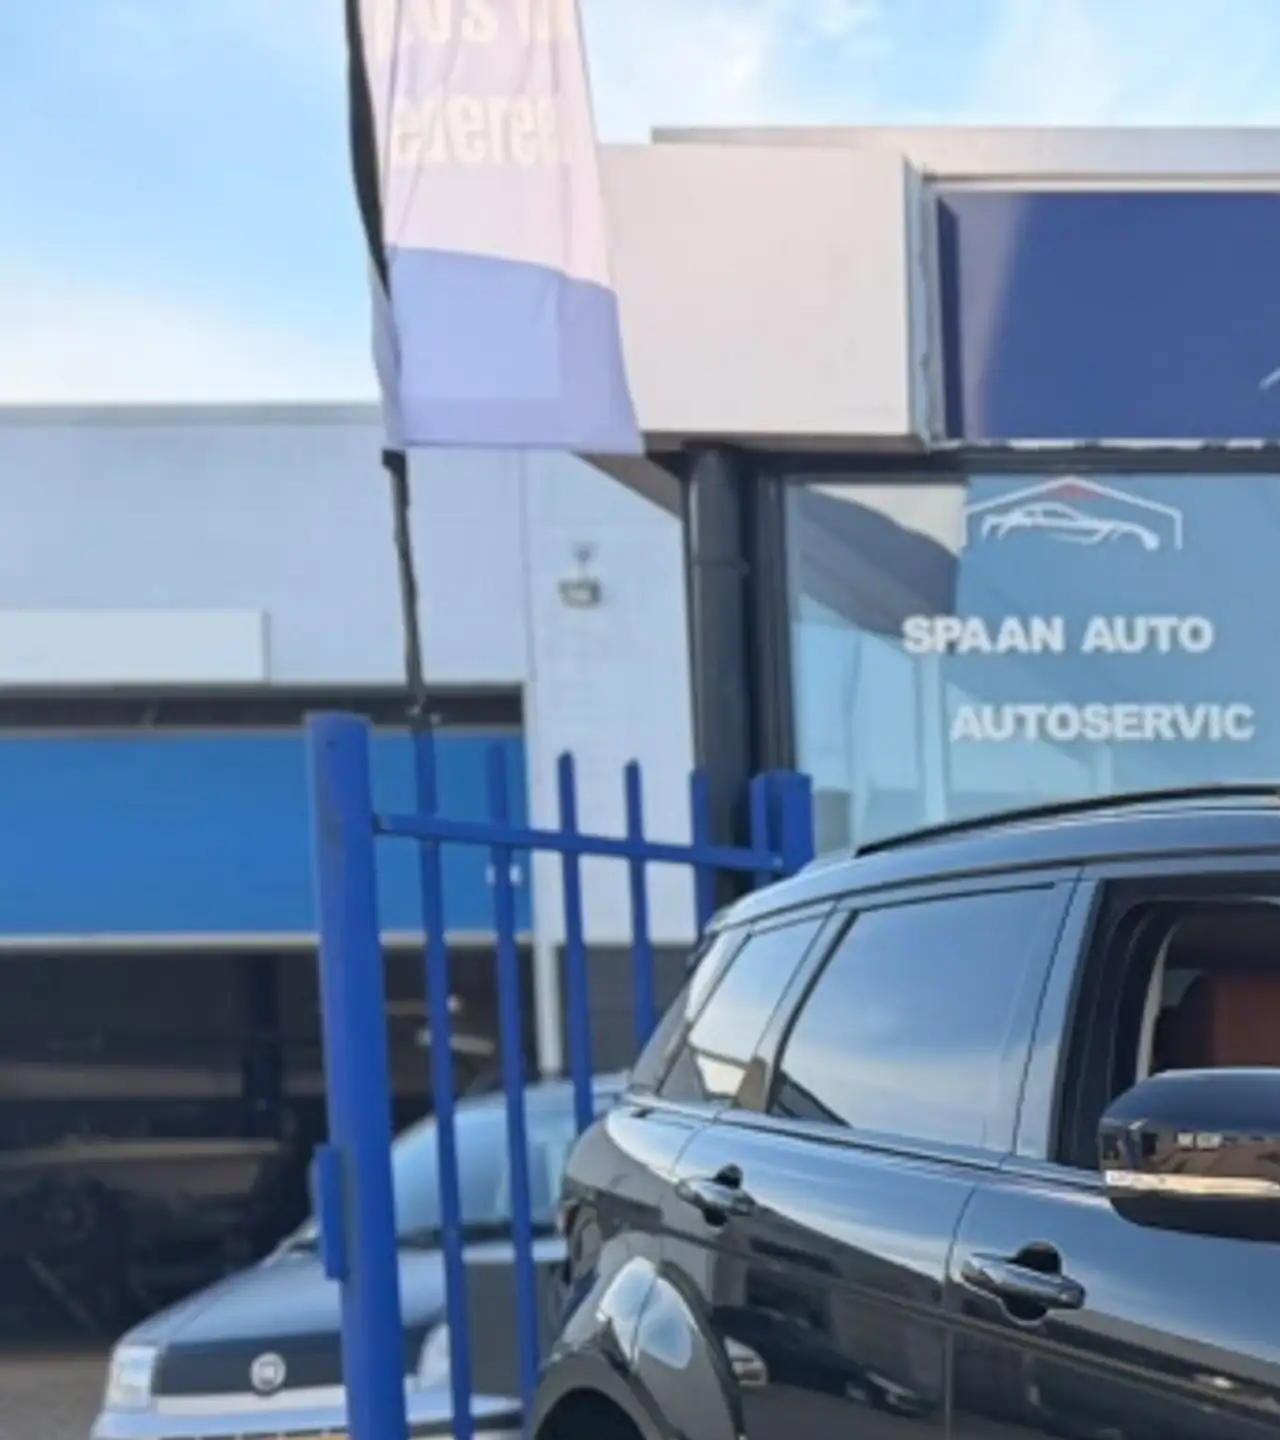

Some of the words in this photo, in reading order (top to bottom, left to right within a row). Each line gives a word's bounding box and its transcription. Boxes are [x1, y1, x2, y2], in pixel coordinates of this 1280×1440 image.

[901, 616, 1066, 656] SPAAN
[1081, 616, 1214, 655] AUTO
[951, 704, 1256, 742] AUTOSERVIC
